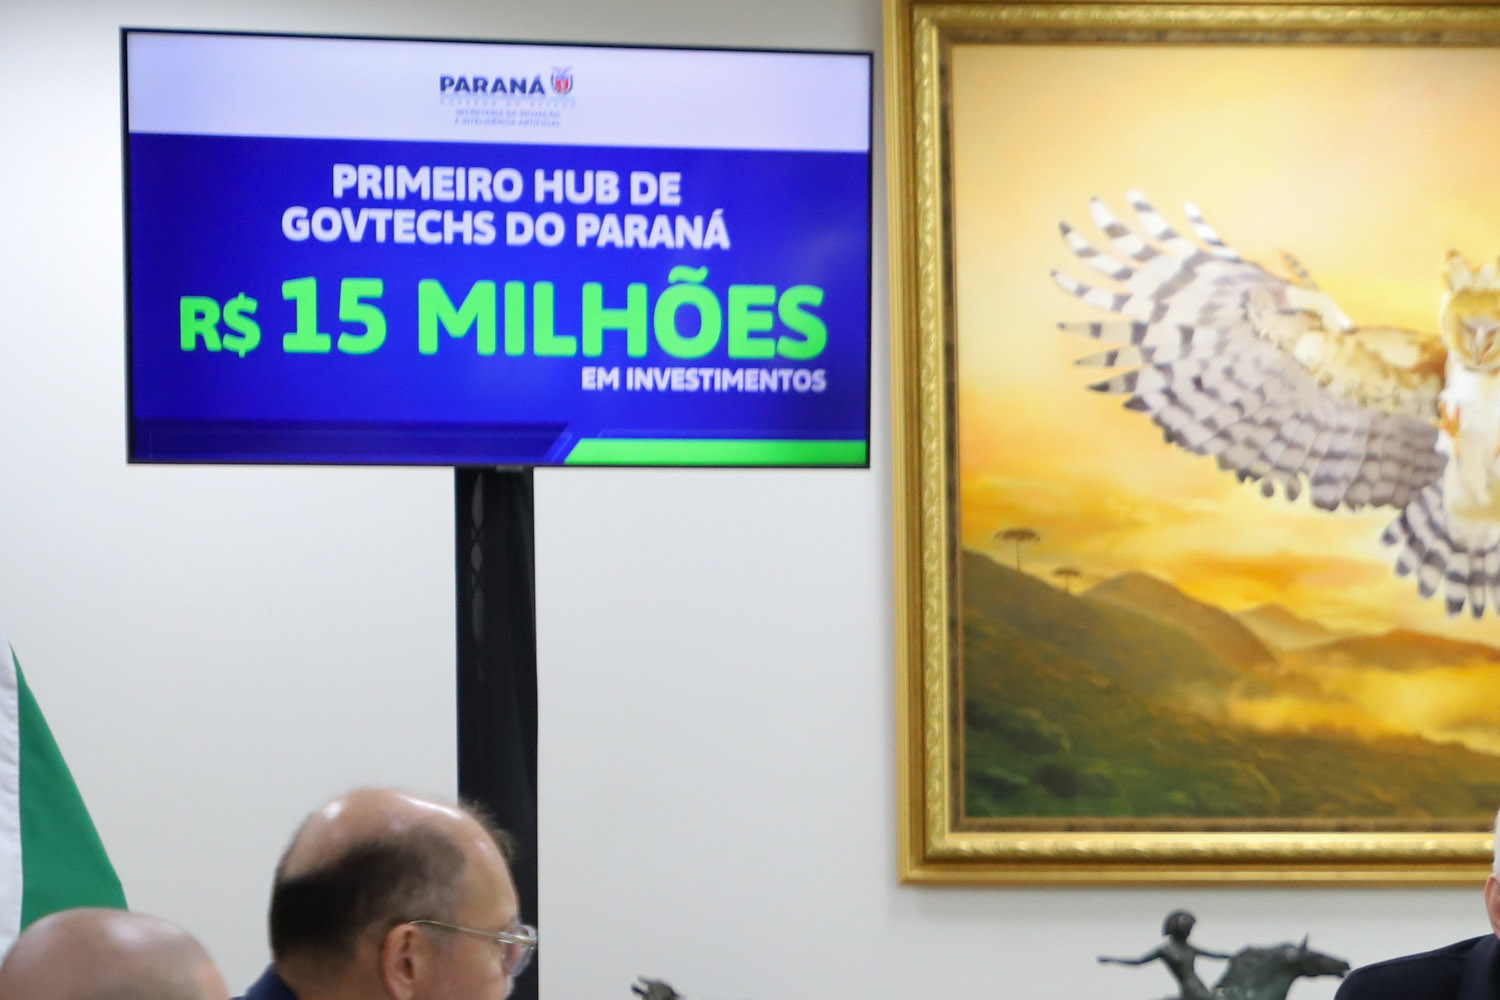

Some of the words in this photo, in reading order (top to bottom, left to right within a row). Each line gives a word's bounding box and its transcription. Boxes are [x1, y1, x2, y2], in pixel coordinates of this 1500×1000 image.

[440, 74, 545, 95] PARANÁ
[333, 164, 523, 202] PRIMEIRO
[535, 170, 619, 204] HUB
[631, 172, 682, 206] DE
[282, 207, 496, 246] GOVTECHS
[506, 212, 564, 246] DO
[577, 209, 730, 249] PARANÁ
[180, 292, 261, 358] R$
[282, 277, 388, 354] 15
[418, 267, 828, 361] MILHÕES
[582, 366, 620, 391] EM
[627, 367, 827, 394] INVESTIMENTOS
